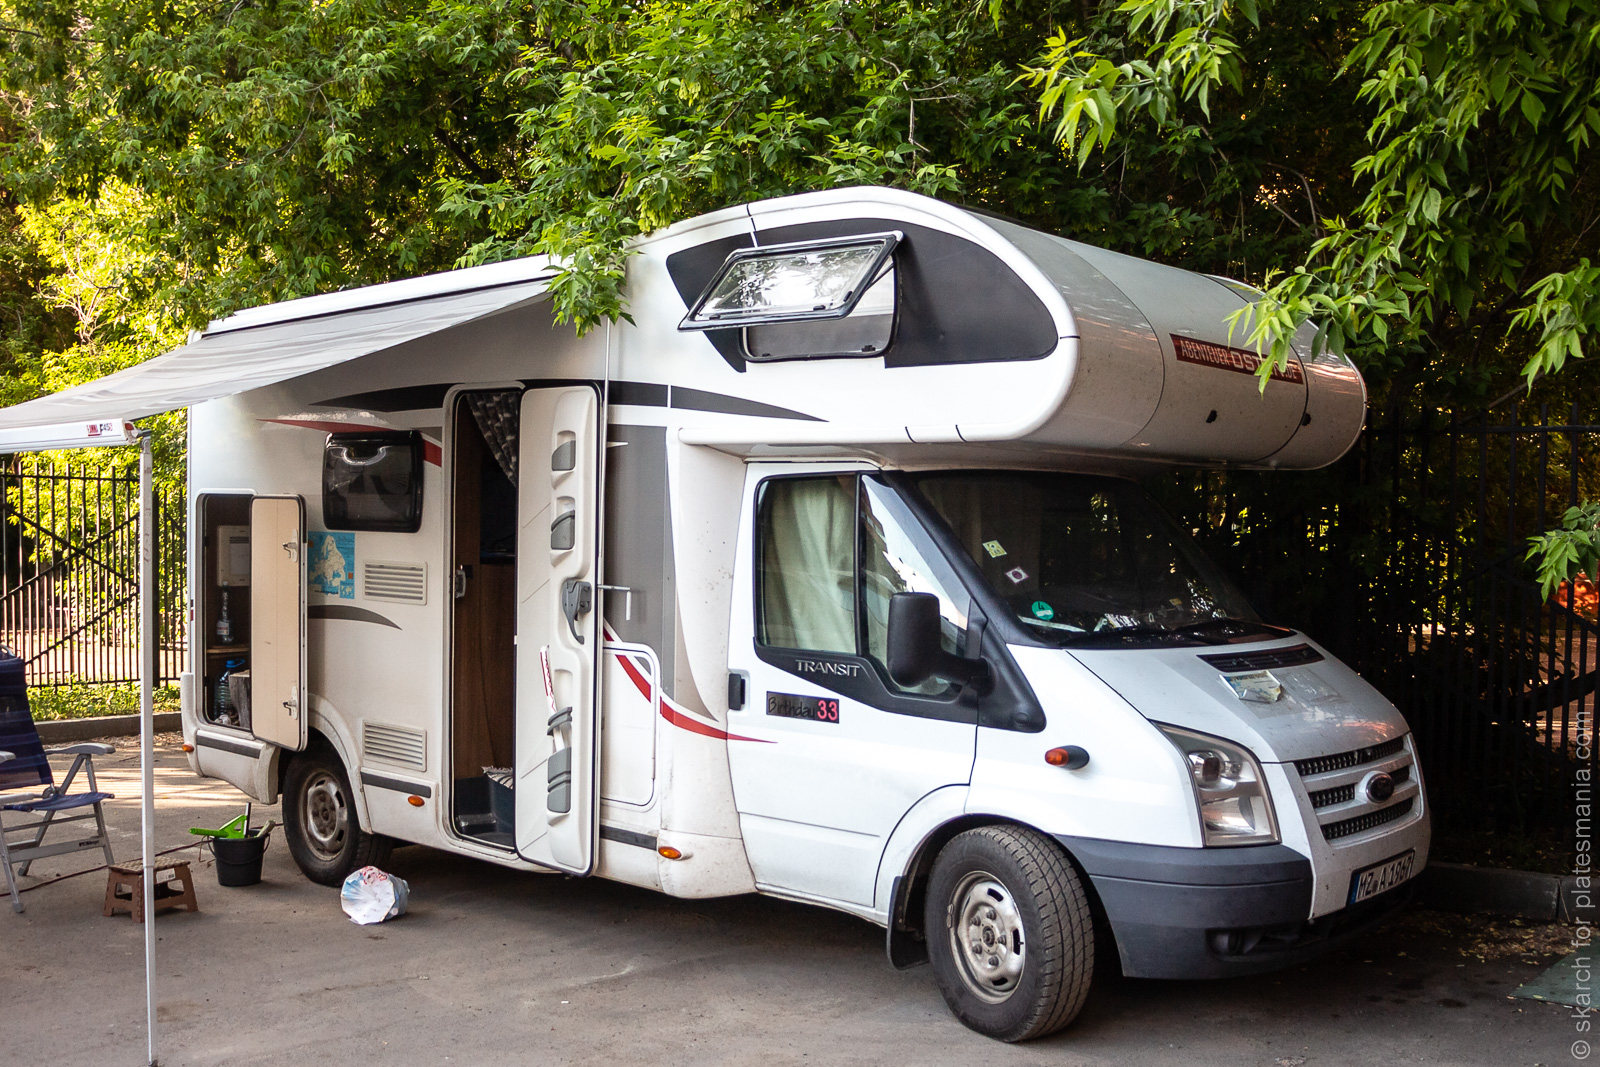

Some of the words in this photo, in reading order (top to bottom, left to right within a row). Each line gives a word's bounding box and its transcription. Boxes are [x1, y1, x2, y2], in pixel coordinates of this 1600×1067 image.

[795, 659, 860, 677] TRANSIT
[817, 699, 838, 721] 33
[1357, 872, 1374, 899] MZ
